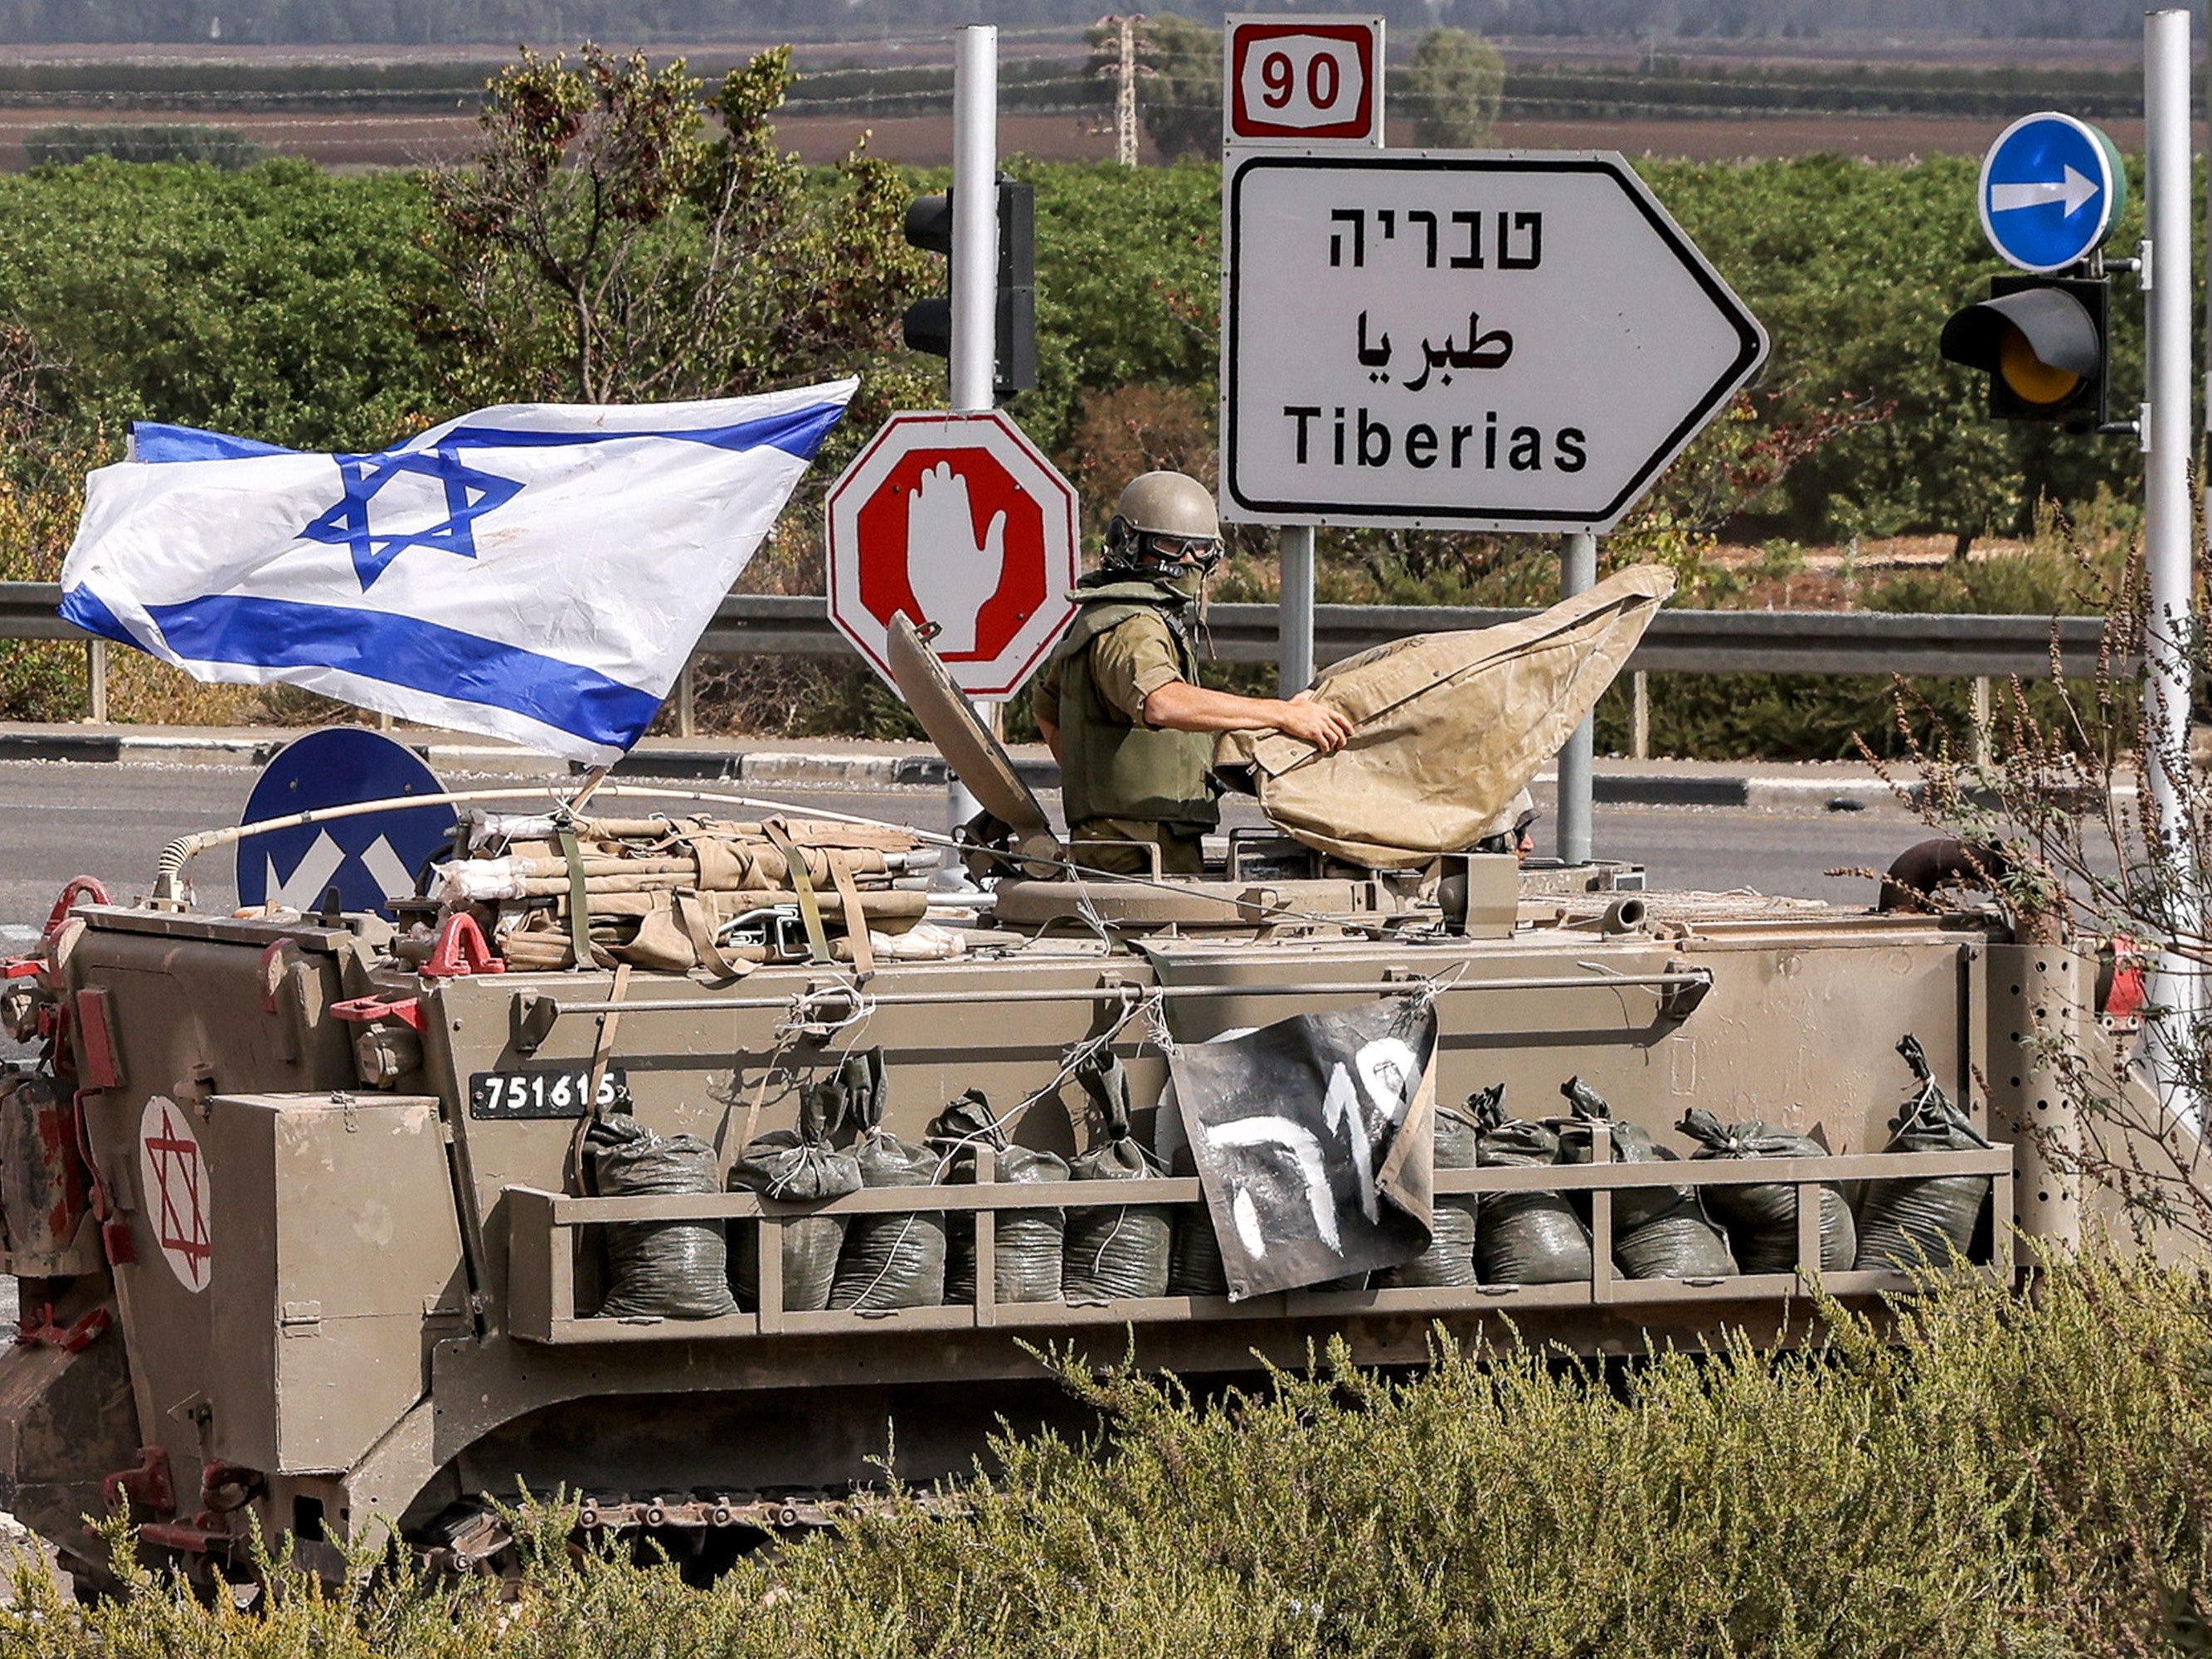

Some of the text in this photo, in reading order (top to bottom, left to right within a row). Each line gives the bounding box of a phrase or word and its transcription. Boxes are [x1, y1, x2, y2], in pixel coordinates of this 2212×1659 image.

[1262, 51, 1339, 109] 90
[1330, 208, 1543, 270] טבריה
[1356, 309, 1513, 392] طبريا
[1283, 406, 1587, 472] Tiberias
[485, 1073, 615, 1109] 751615
